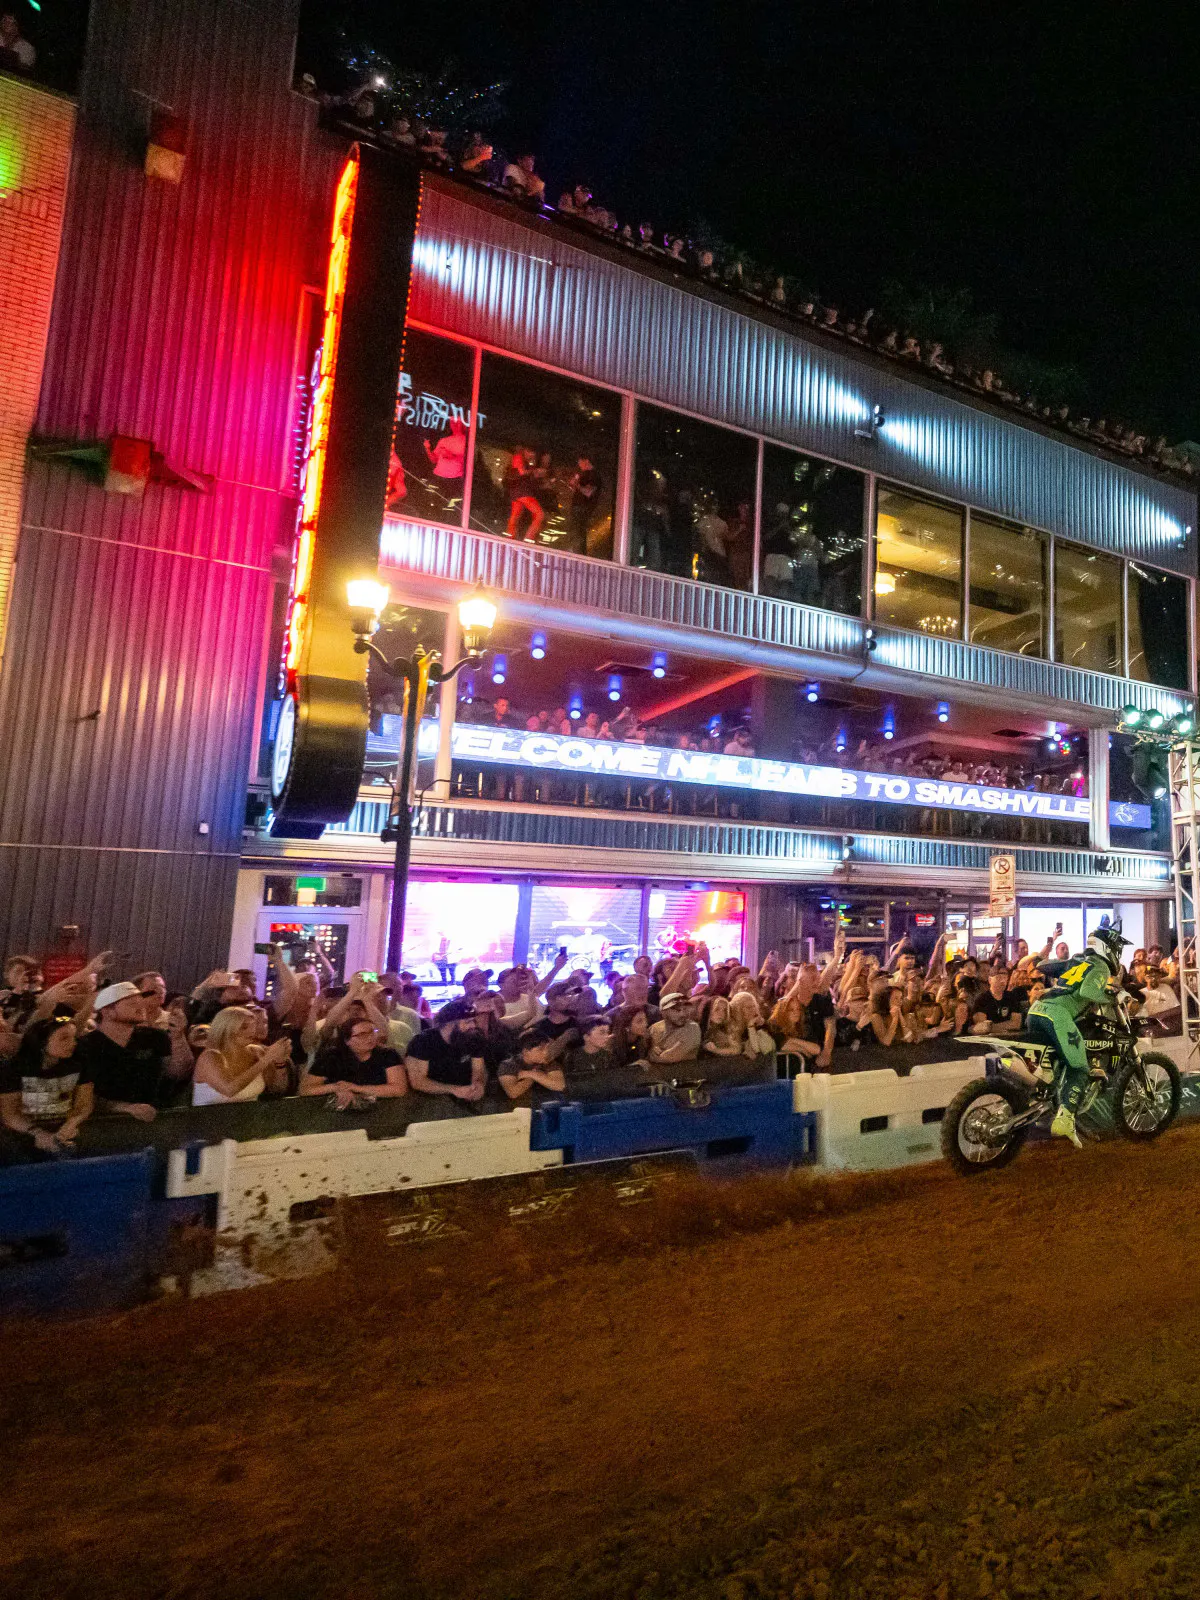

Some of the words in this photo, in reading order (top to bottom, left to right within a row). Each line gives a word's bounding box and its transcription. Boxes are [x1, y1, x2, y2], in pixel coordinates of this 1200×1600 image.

[418, 721, 661, 776] WELCOME
[865, 774, 910, 801] TO
[914, 782, 1091, 820] SMASHVILLE
[1060, 961, 1092, 986] 4
